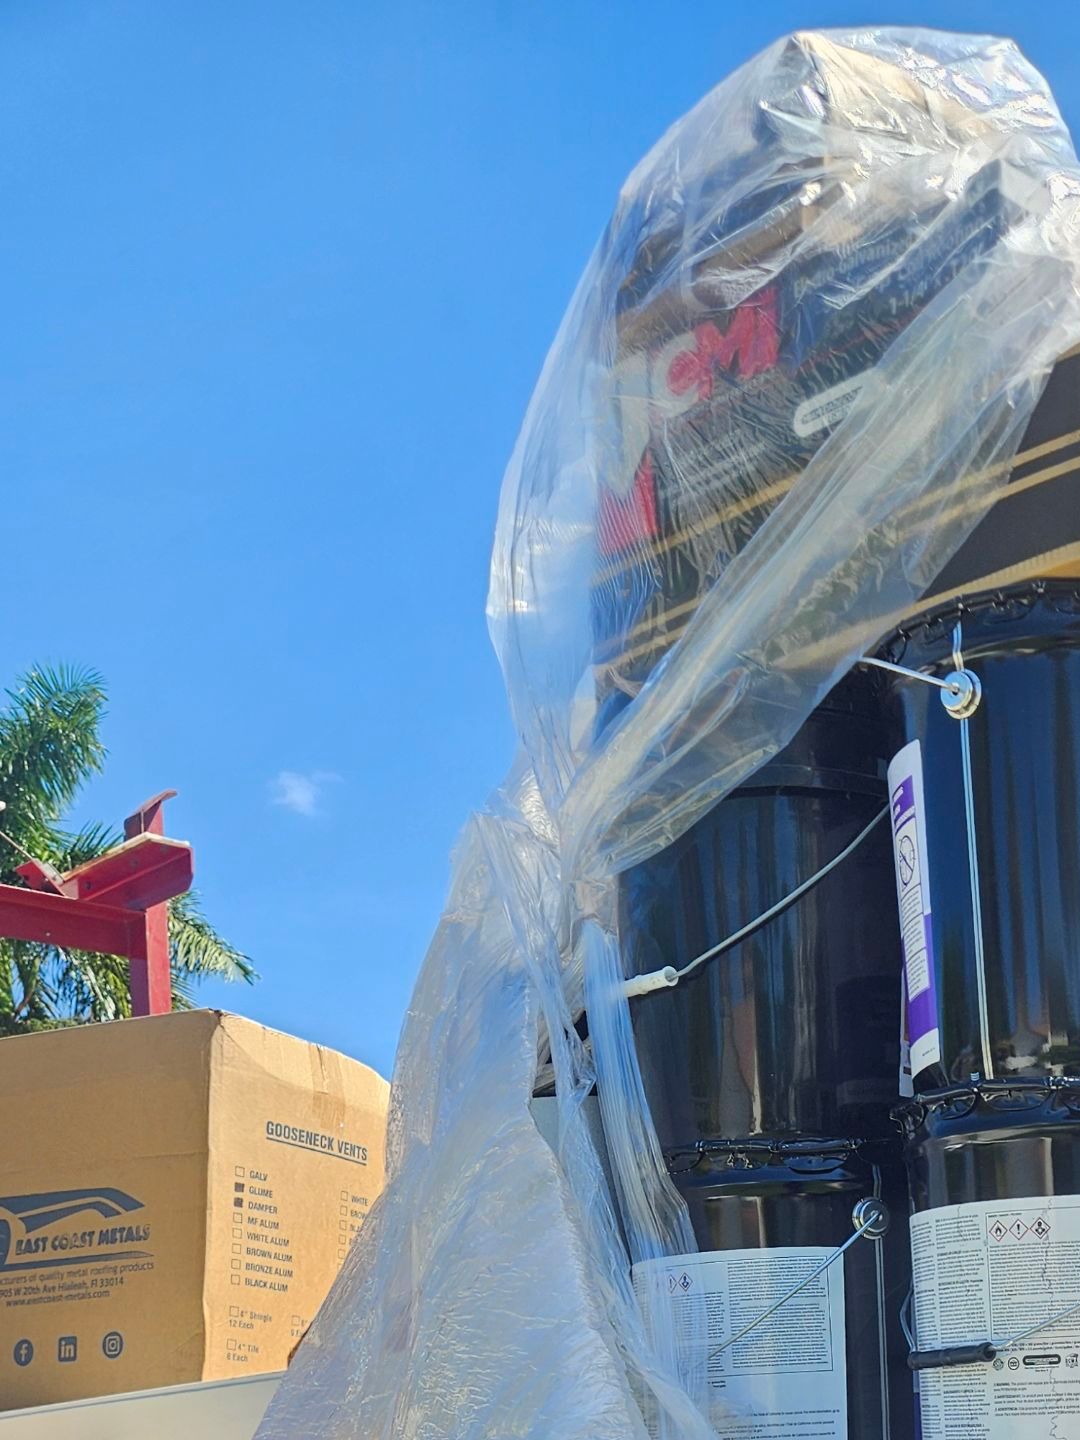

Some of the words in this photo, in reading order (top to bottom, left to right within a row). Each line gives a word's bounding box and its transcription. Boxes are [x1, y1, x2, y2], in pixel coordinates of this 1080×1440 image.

[266, 1121, 334, 1151] GOOSENECK
[337, 1140, 367, 1161] VENTS
[250, 1170, 268, 1181] GALV
[248, 1201, 278, 1215] DAMPER
[260, 1219, 279, 1230] ALUM
[16, 1237, 48, 1256] EAST
[51, 1230, 95, 1251] COAST
[97, 1224, 151, 1246] METALS
[247, 1231, 269, 1244] WHITE
[270, 1235, 289, 1247] ALUM
[246, 1247, 272, 1259] BROWN
[273, 1250, 293, 1262] ALUM
[120, 1261, 154, 1274] products
[245, 1262, 273, 1275] BRONZE
[274, 1266, 293, 1278] ALUM
[99, 1276, 124, 1288] 33014
[245, 1277, 268, 1289] BLACK
[269, 1280, 288, 1292] ALUM
